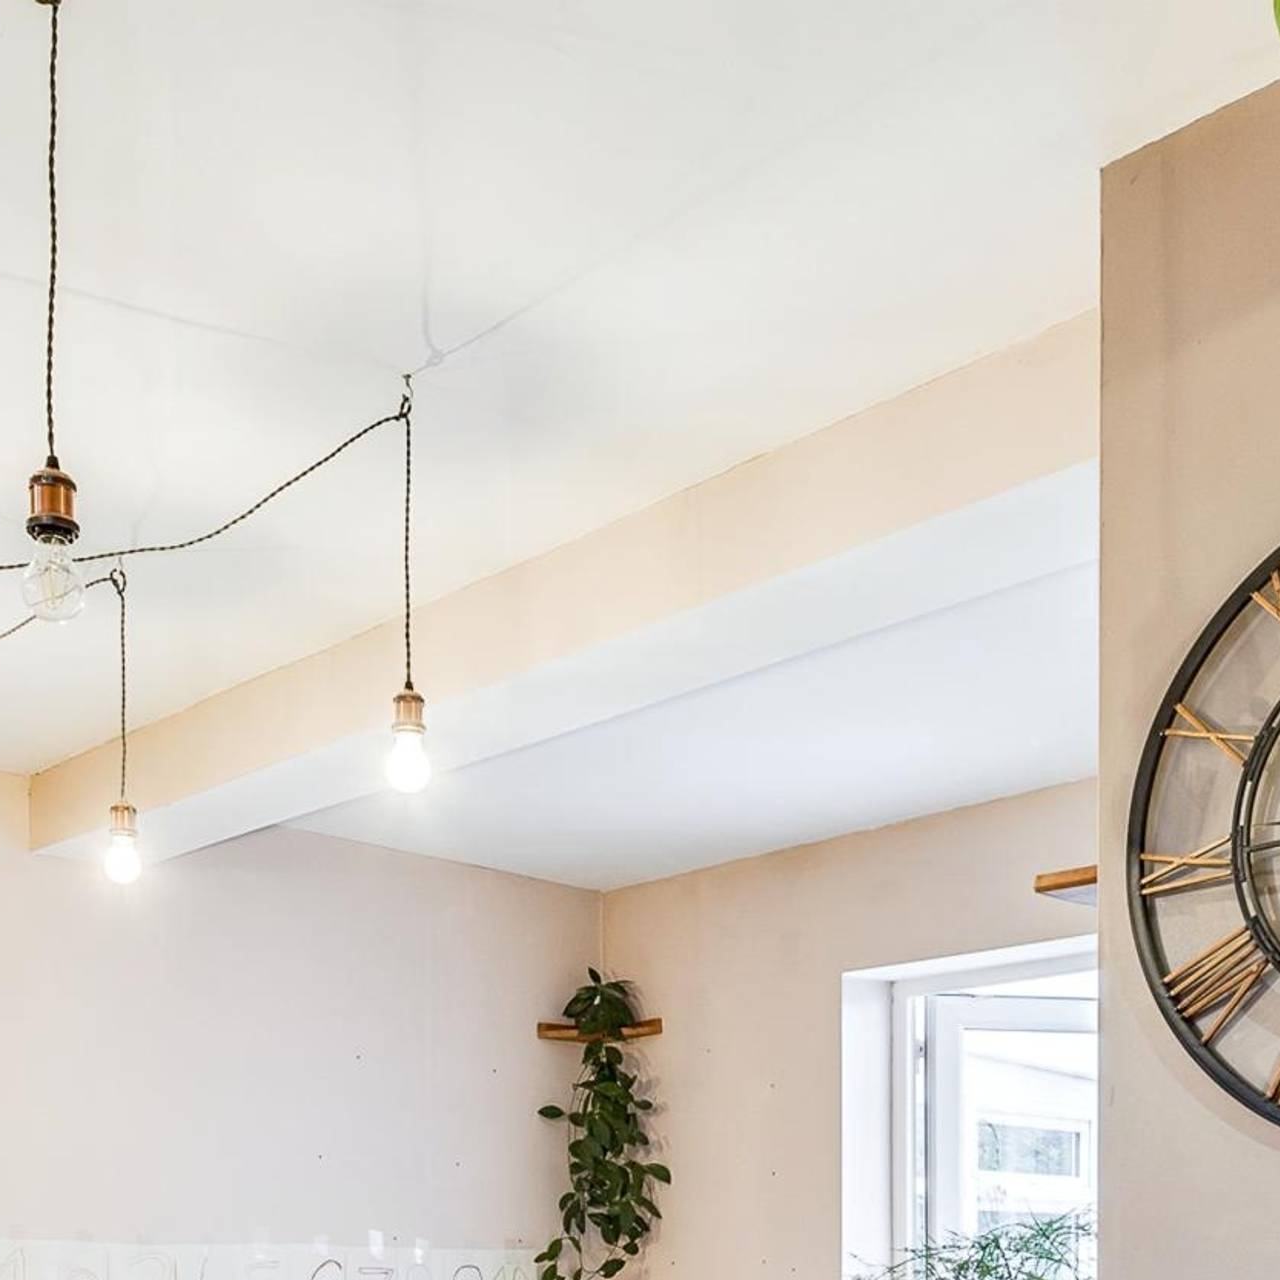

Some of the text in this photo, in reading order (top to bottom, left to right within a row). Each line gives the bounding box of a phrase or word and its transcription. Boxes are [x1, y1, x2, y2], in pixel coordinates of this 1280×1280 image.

[1162, 701, 1258, 767] X
[1139, 836, 1233, 896] IX
[1162, 926, 1271, 1043] VIII
